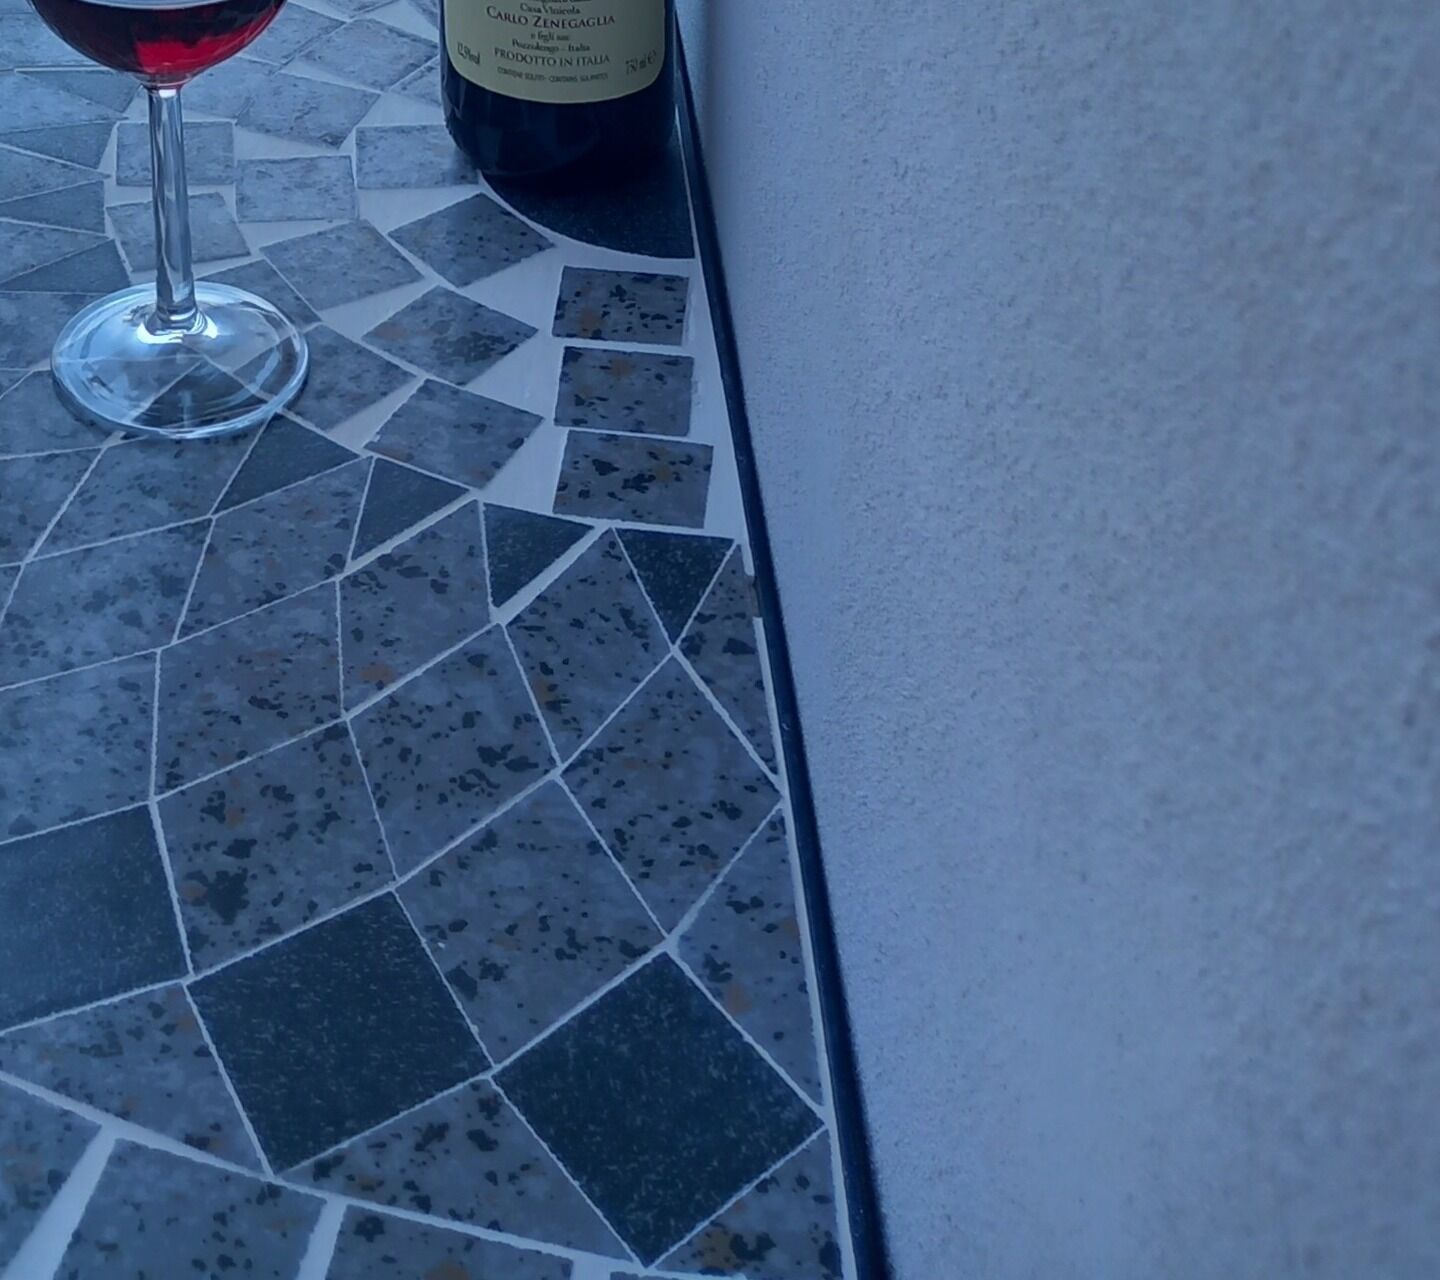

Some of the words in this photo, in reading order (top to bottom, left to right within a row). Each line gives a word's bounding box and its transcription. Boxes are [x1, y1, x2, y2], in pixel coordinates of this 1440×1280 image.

[486, 5, 528, 26] CARLO
[532, 15, 616, 29] ZENEGAGLIA
[494, 47, 557, 67] PRODOTTO
[560, 56, 573, 67] IN
[576, 53, 610, 66] ITALIA
